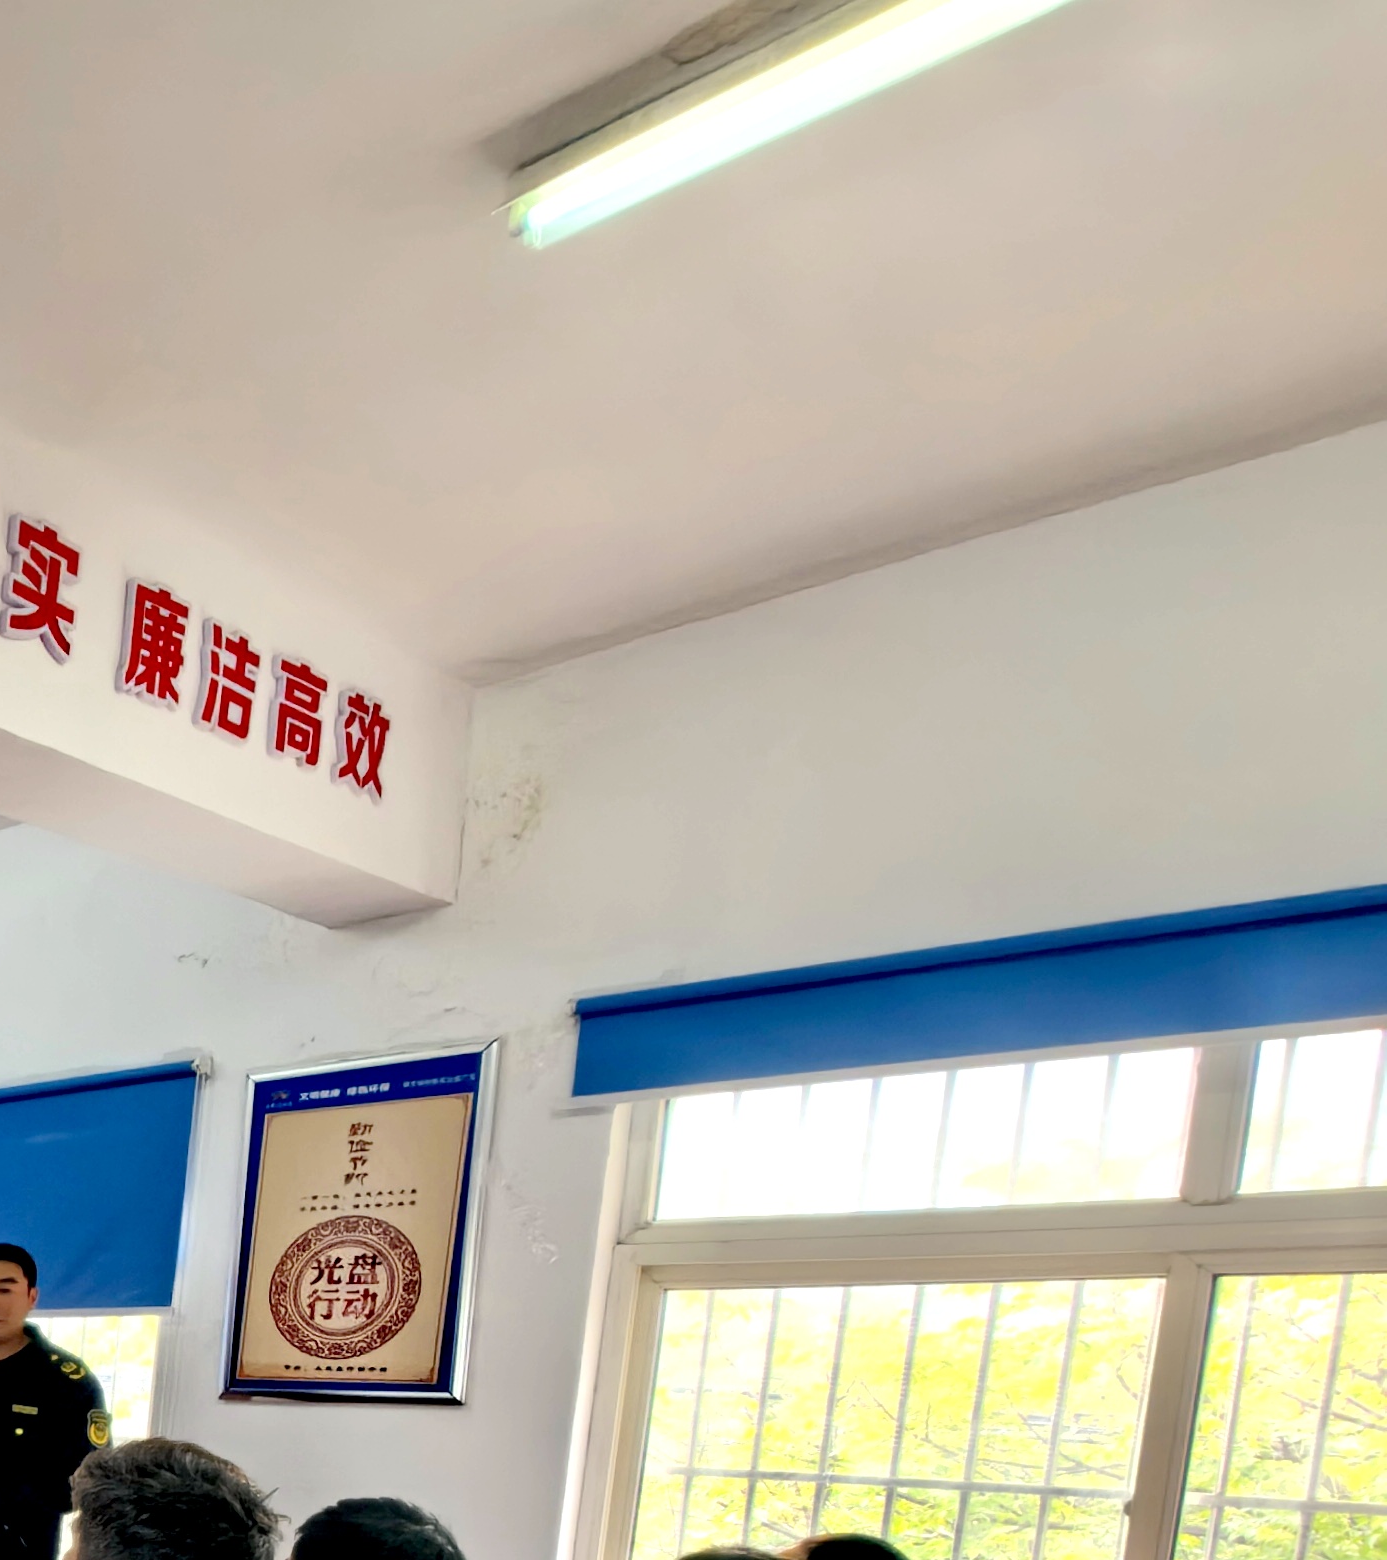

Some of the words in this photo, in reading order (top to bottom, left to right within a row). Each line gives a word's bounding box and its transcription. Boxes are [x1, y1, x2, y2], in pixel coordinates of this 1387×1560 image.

[123, 582, 392, 801] 廉洁高效
[309, 1253, 382, 1285] 光盘
[307, 1288, 379, 1320] 行动
